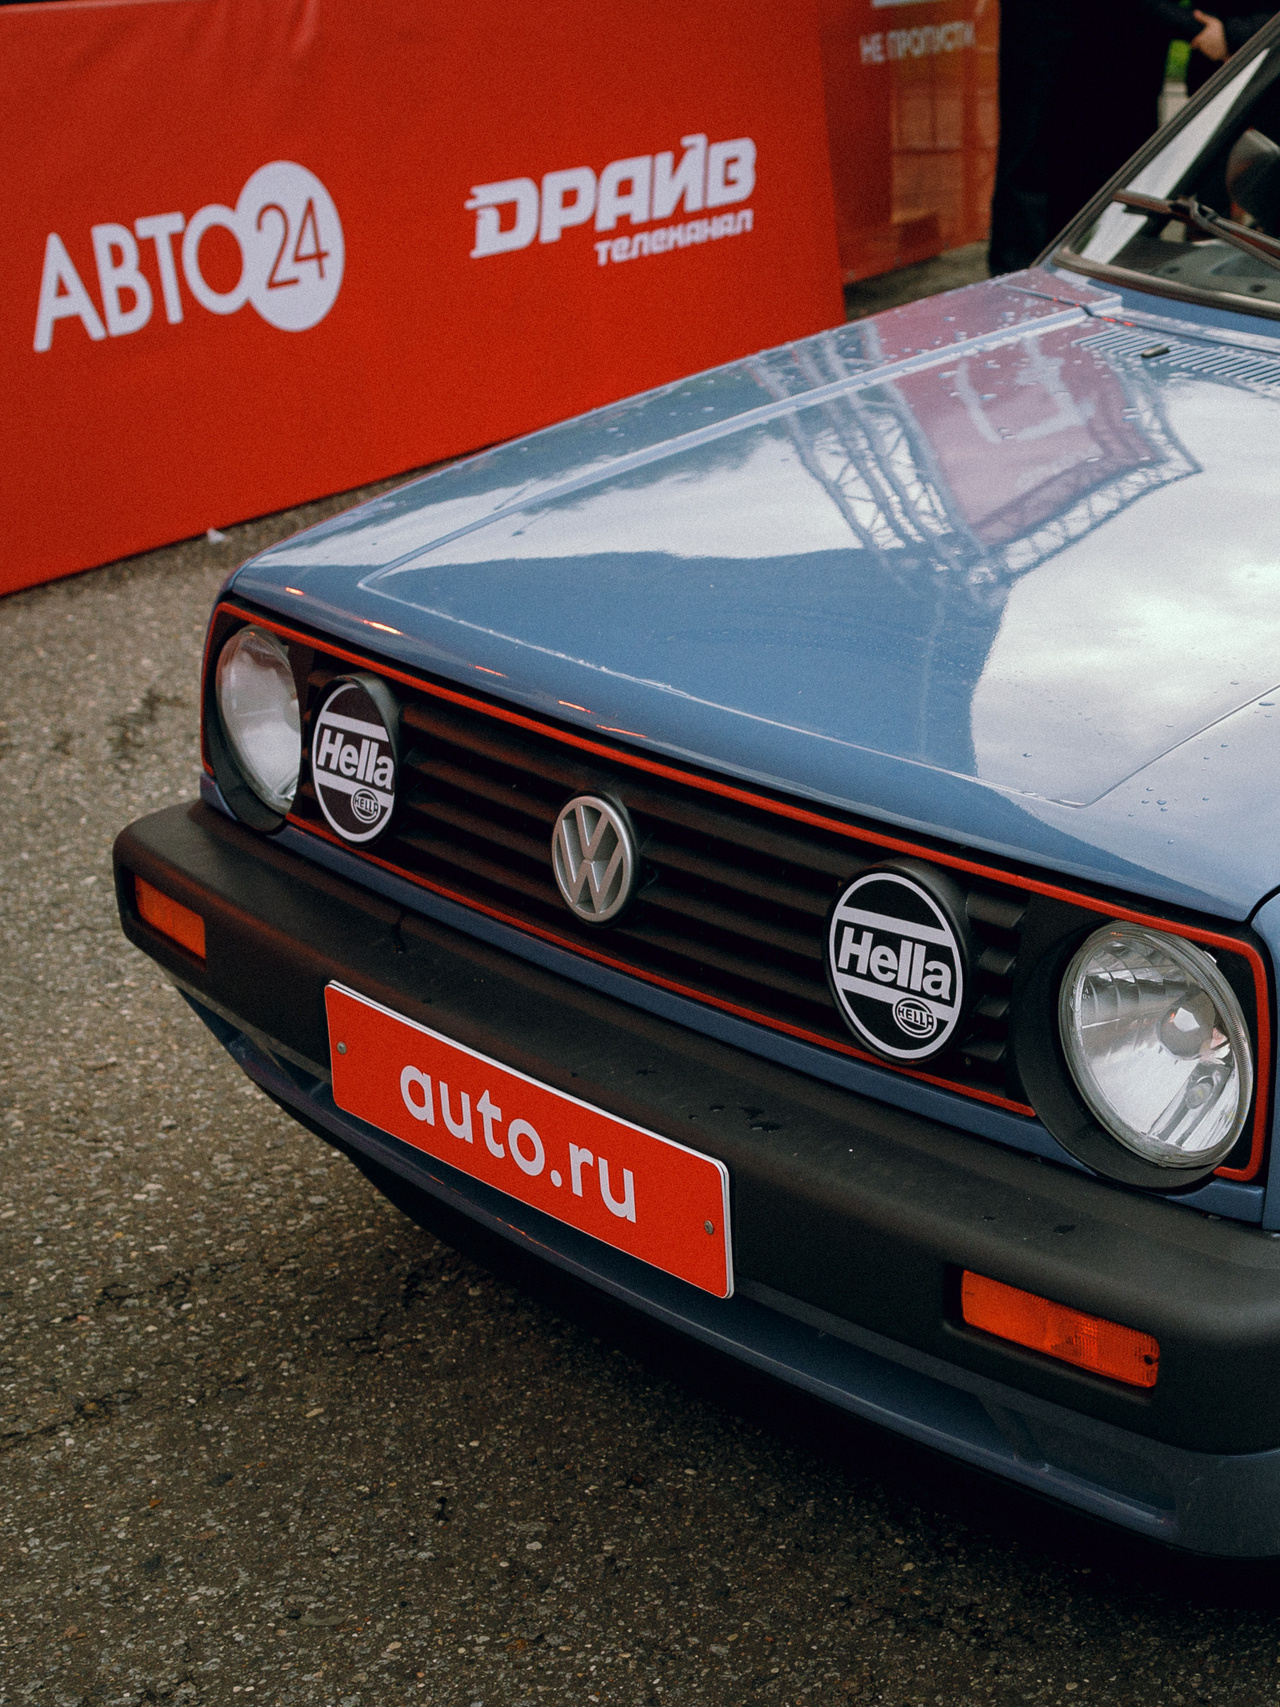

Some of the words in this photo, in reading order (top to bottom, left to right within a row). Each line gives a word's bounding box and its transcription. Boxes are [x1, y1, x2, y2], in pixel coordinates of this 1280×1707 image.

[317, 728, 395, 790] Hella
[837, 926, 952, 1001] Hella
[898, 1005, 934, 1030] HELLA
[400, 1064, 637, 1224] auto.ru
